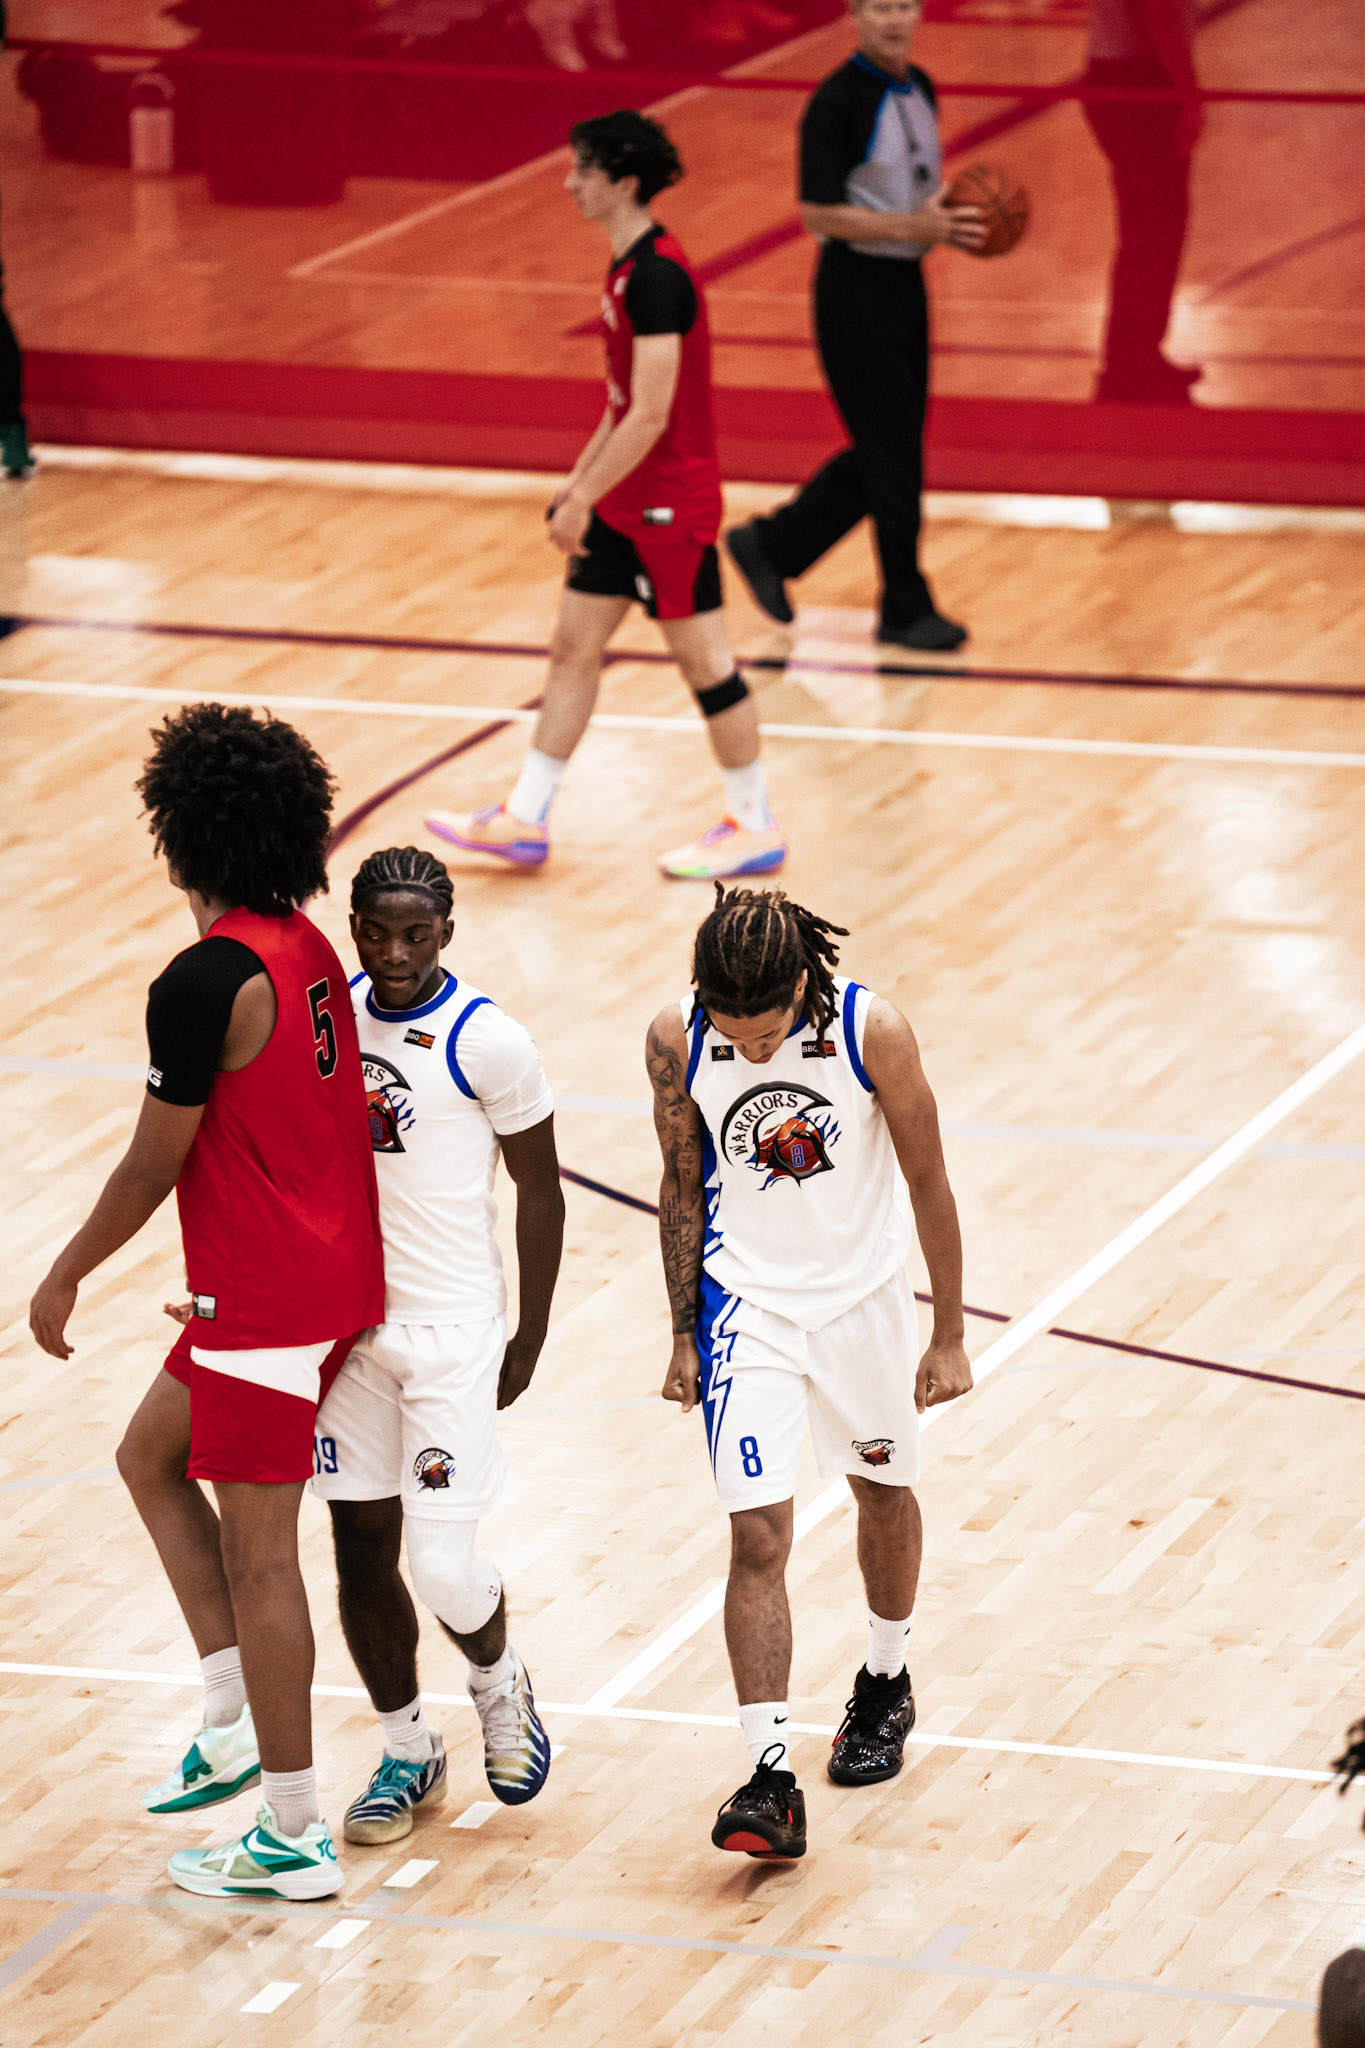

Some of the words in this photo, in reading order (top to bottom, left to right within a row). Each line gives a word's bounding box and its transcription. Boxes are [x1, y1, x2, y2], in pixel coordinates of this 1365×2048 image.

[306, 977, 338, 1080] 5
[728, 1092, 798, 1157] WARRIORS
[790, 1143, 804, 1169] 8
[415, 1451, 443, 1477] WARRIORS
[739, 1435, 763, 1478] 8
